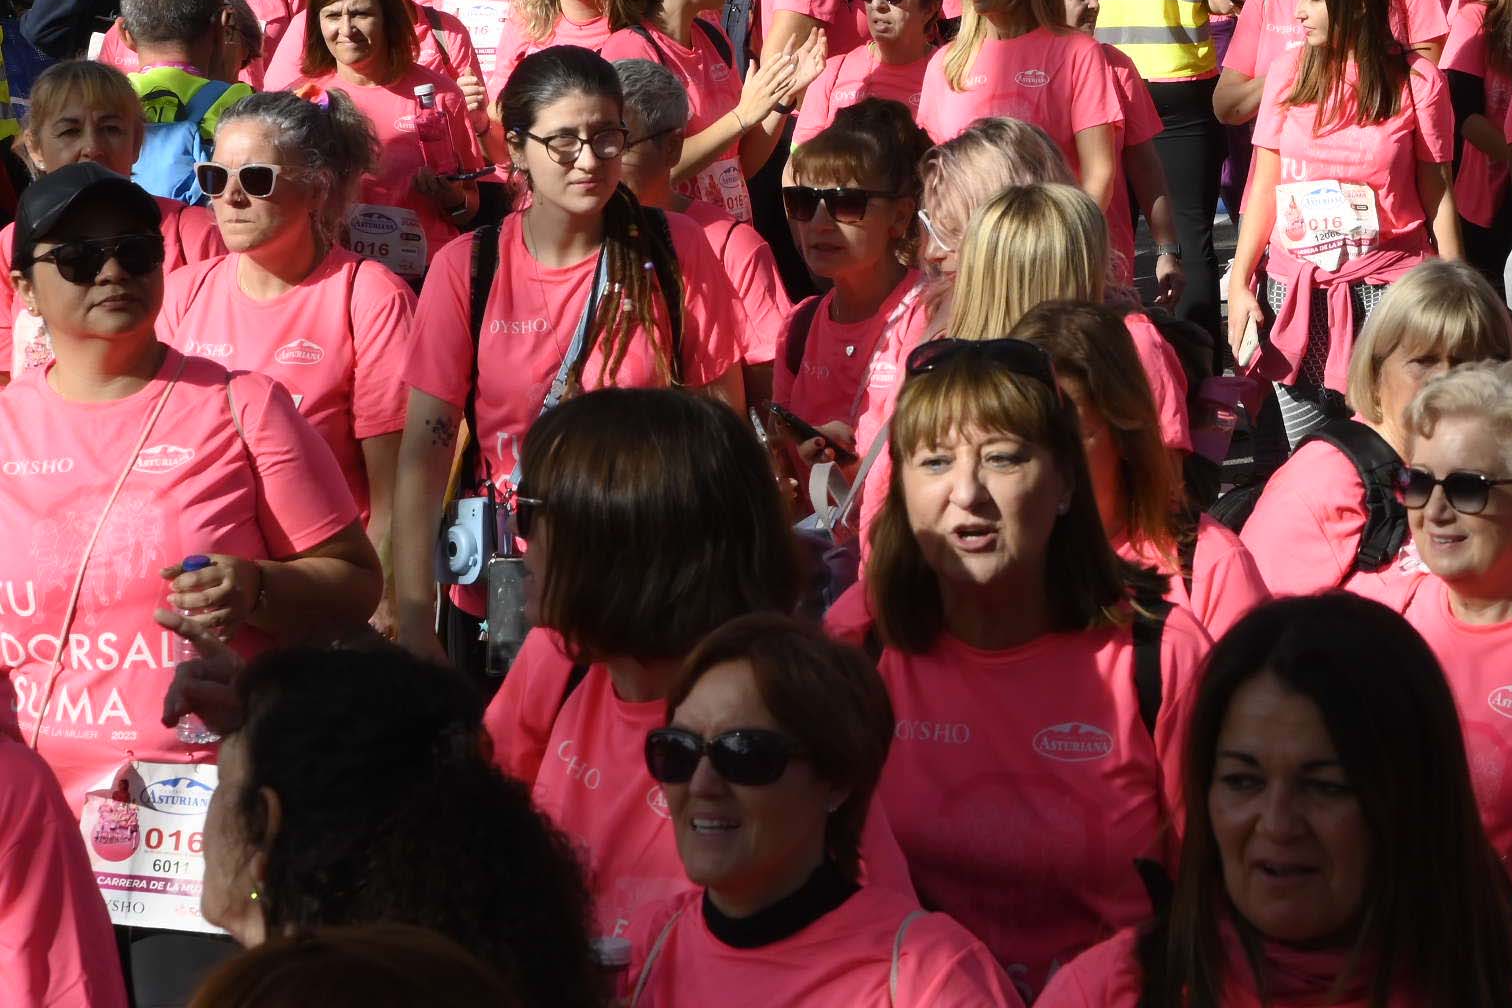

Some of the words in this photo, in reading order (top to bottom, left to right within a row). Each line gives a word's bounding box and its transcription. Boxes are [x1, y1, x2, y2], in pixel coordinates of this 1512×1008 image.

[1281, 157, 1307, 181] TU
[489, 318, 547, 334] OYSHO
[3, 457, 74, 476] OYSHO
[0, 630, 177, 671] DORSAL
[12, 676, 132, 726] SUMA
[1039, 736, 1109, 753] ASTURIANA
[147, 791, 209, 808] ASTURIAN
[97, 876, 147, 888] CARRERA
[150, 879, 166, 890] DE
[105, 899, 145, 914] SHO
